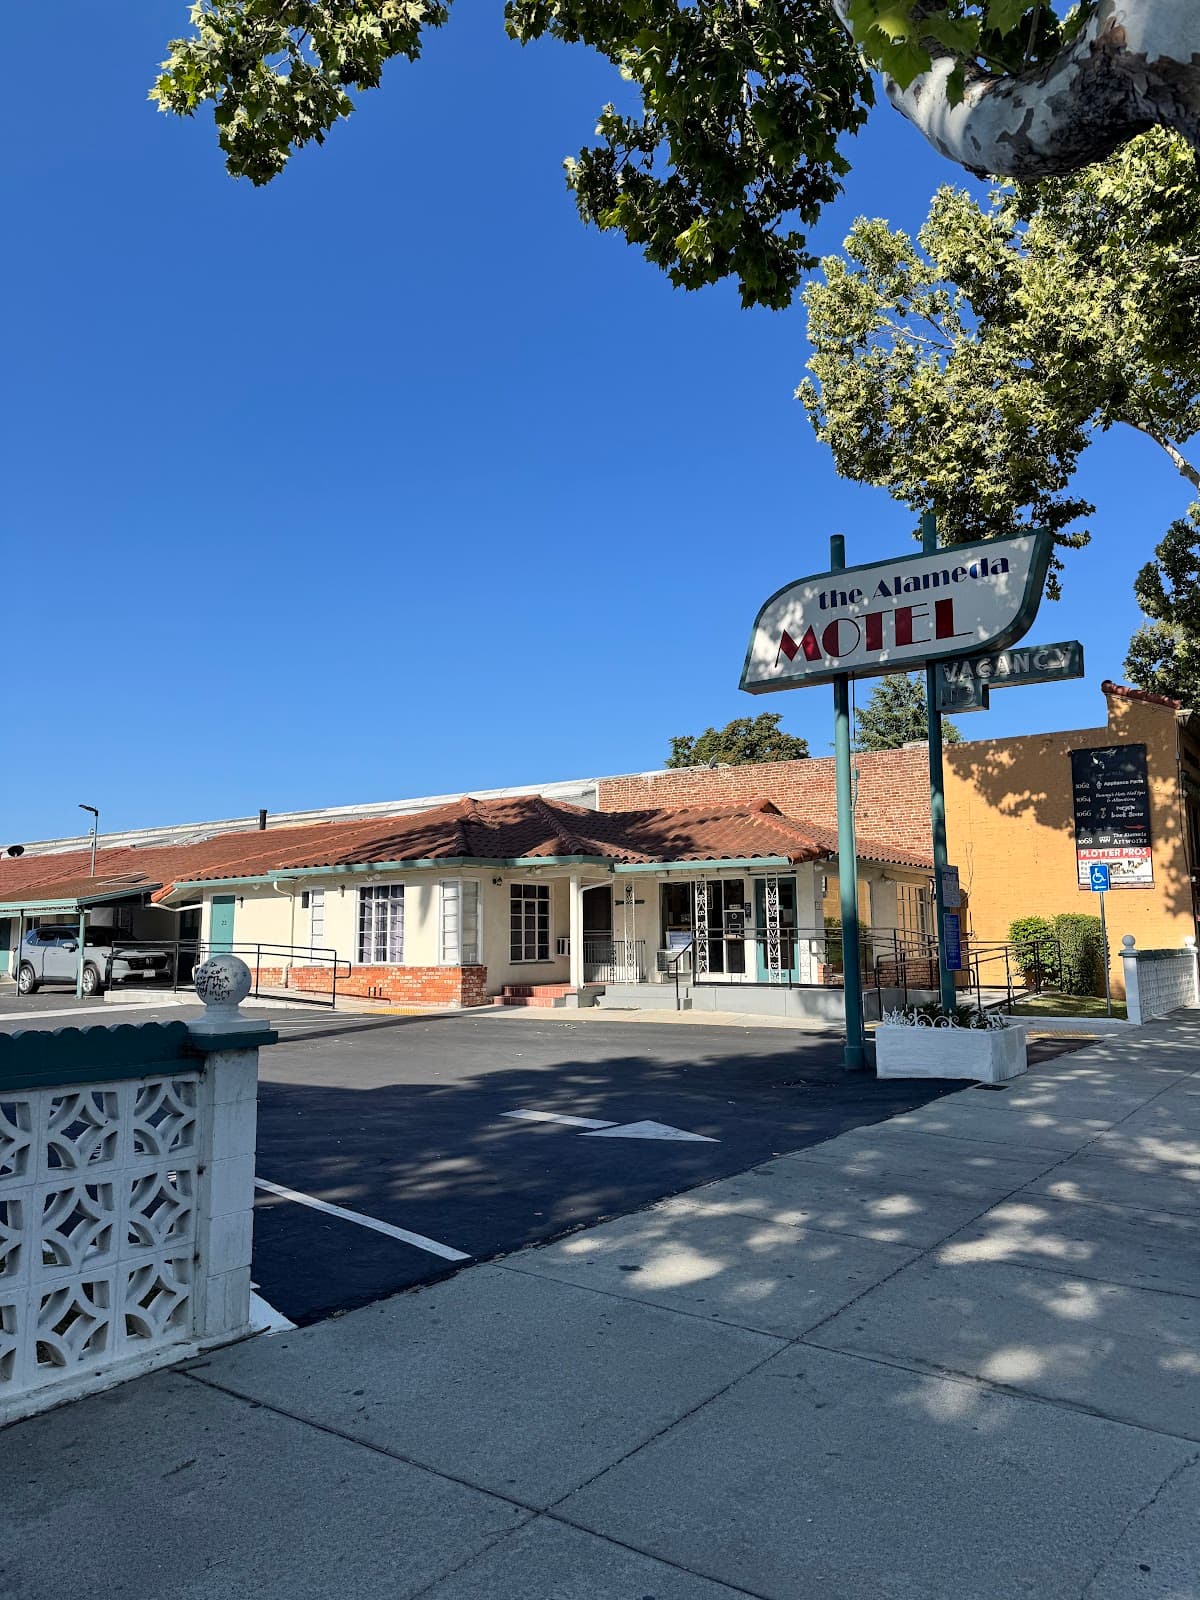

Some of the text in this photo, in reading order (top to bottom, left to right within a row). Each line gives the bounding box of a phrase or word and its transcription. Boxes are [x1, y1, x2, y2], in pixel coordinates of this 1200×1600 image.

[818, 556, 1010, 611] the Alameda
[774, 597, 974, 669] MOTEL
[943, 647, 1072, 683] VACANCY
[1080, 847, 1147, 858] PLOTTER PROS
